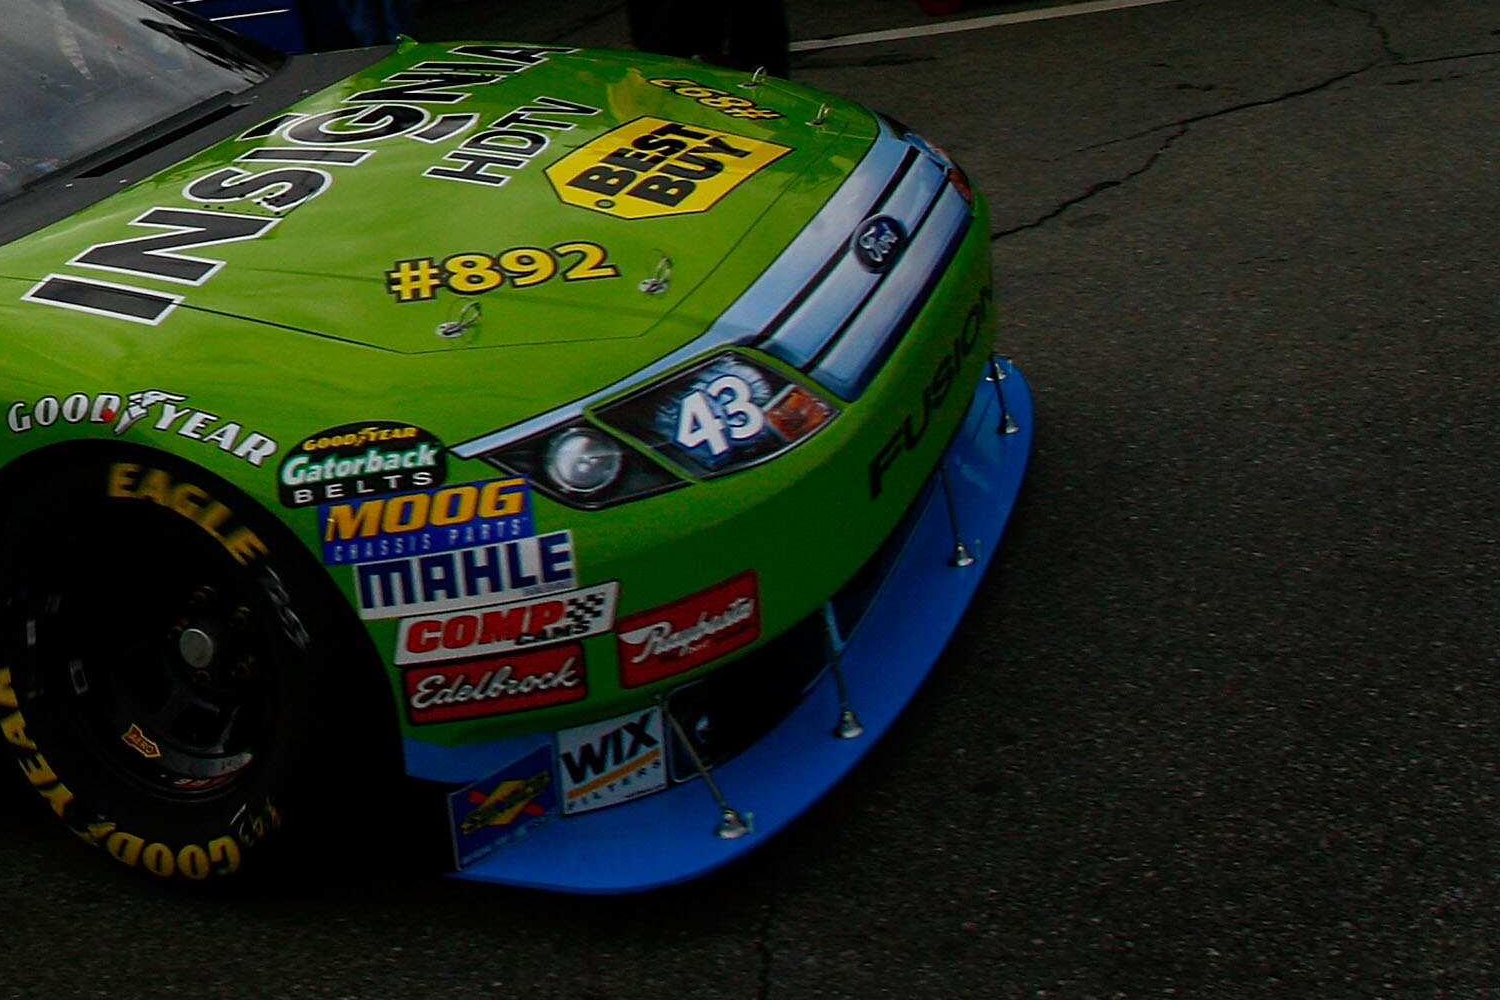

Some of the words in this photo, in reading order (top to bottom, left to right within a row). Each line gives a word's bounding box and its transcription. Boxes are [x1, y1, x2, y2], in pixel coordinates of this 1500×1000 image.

[421, 95, 604, 187] HDTV
[565, 122, 711, 199] BEST
[626, 135, 752, 207] BUY
[20, 44, 581, 327] INSIGNIA
[385, 240, 621, 302] #892
[675, 374, 766, 459] 43
[868, 285, 993, 500] FUSION
[7, 391, 279, 467] GOODYEAR
[302, 427, 419, 452] GOODYEAR
[280, 445, 439, 486] Gatorback
[294, 472, 434, 504] BELTS
[108, 461, 270, 567] EAGLE
[325, 477, 528, 543] MOOG
[334, 533, 432, 563] CHASSIS
[450, 518, 521, 546] PARTS
[357, 531, 573, 610] MAHLE
[405, 600, 566, 654] COMP
[514, 622, 592, 646] CAMS
[410, 656, 580, 710] Edelbrock
[562, 713, 658, 785] WIX
[566, 758, 663, 811] FILTERS
